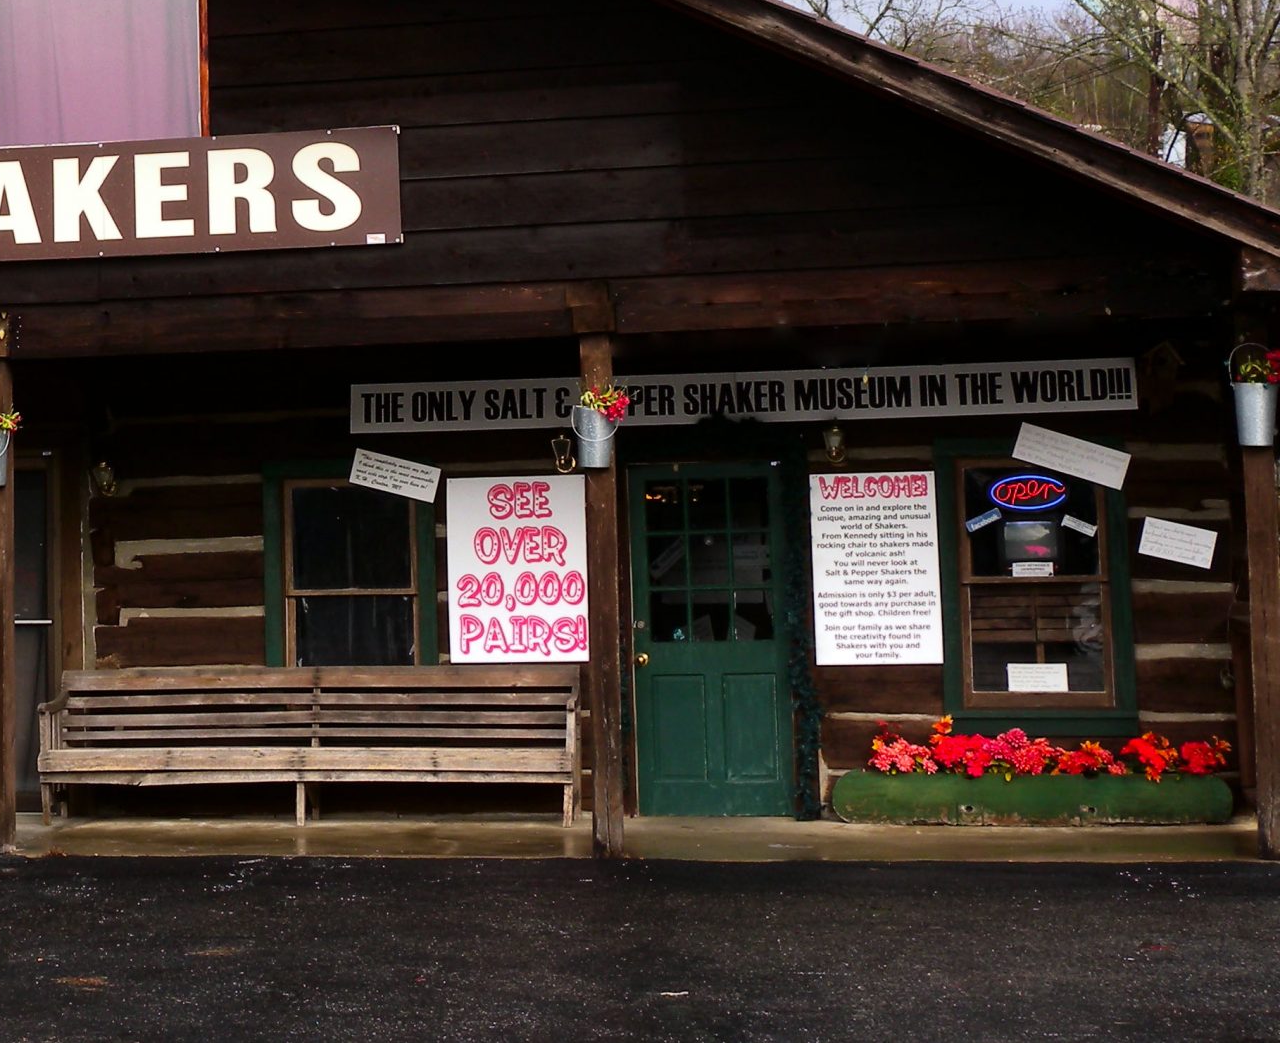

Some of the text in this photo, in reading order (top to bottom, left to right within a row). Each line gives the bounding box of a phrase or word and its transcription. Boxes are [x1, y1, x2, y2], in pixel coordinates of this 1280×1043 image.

[360, 392, 404, 423] THE
[411, 389, 476, 421] ONLY
[484, 387, 547, 420] SALT
[555, 387, 573, 418] &
[683, 380, 786, 415] SHAKER
[794, 375, 912, 411] MUSEUM
[919, 374, 947, 407] IN
[955, 371, 1004, 406] THE
[1010, 367, 1132, 404] WORLD!!!
[818, 474, 928, 499] WELCOME!
[486, 481, 552, 519] SEE
[882, 504, 911, 512] explore
[848, 514, 880, 522] amazing
[843, 532, 877, 540] Kennedy
[474, 525, 567, 566] OVER
[816, 542, 845, 550] rocking
[851, 569, 878, 577] Pepper
[884, 578, 907, 586] again.
[456, 571, 586, 611] 20,000
[867, 591, 884, 599] only
[818, 601, 838, 609] good
[890, 600, 926, 608] purchase
[838, 610, 852, 618] gift
[857, 624, 881, 632] family
[459, 615, 588, 655] PAIRS!
[849, 633, 886, 641] creativity
